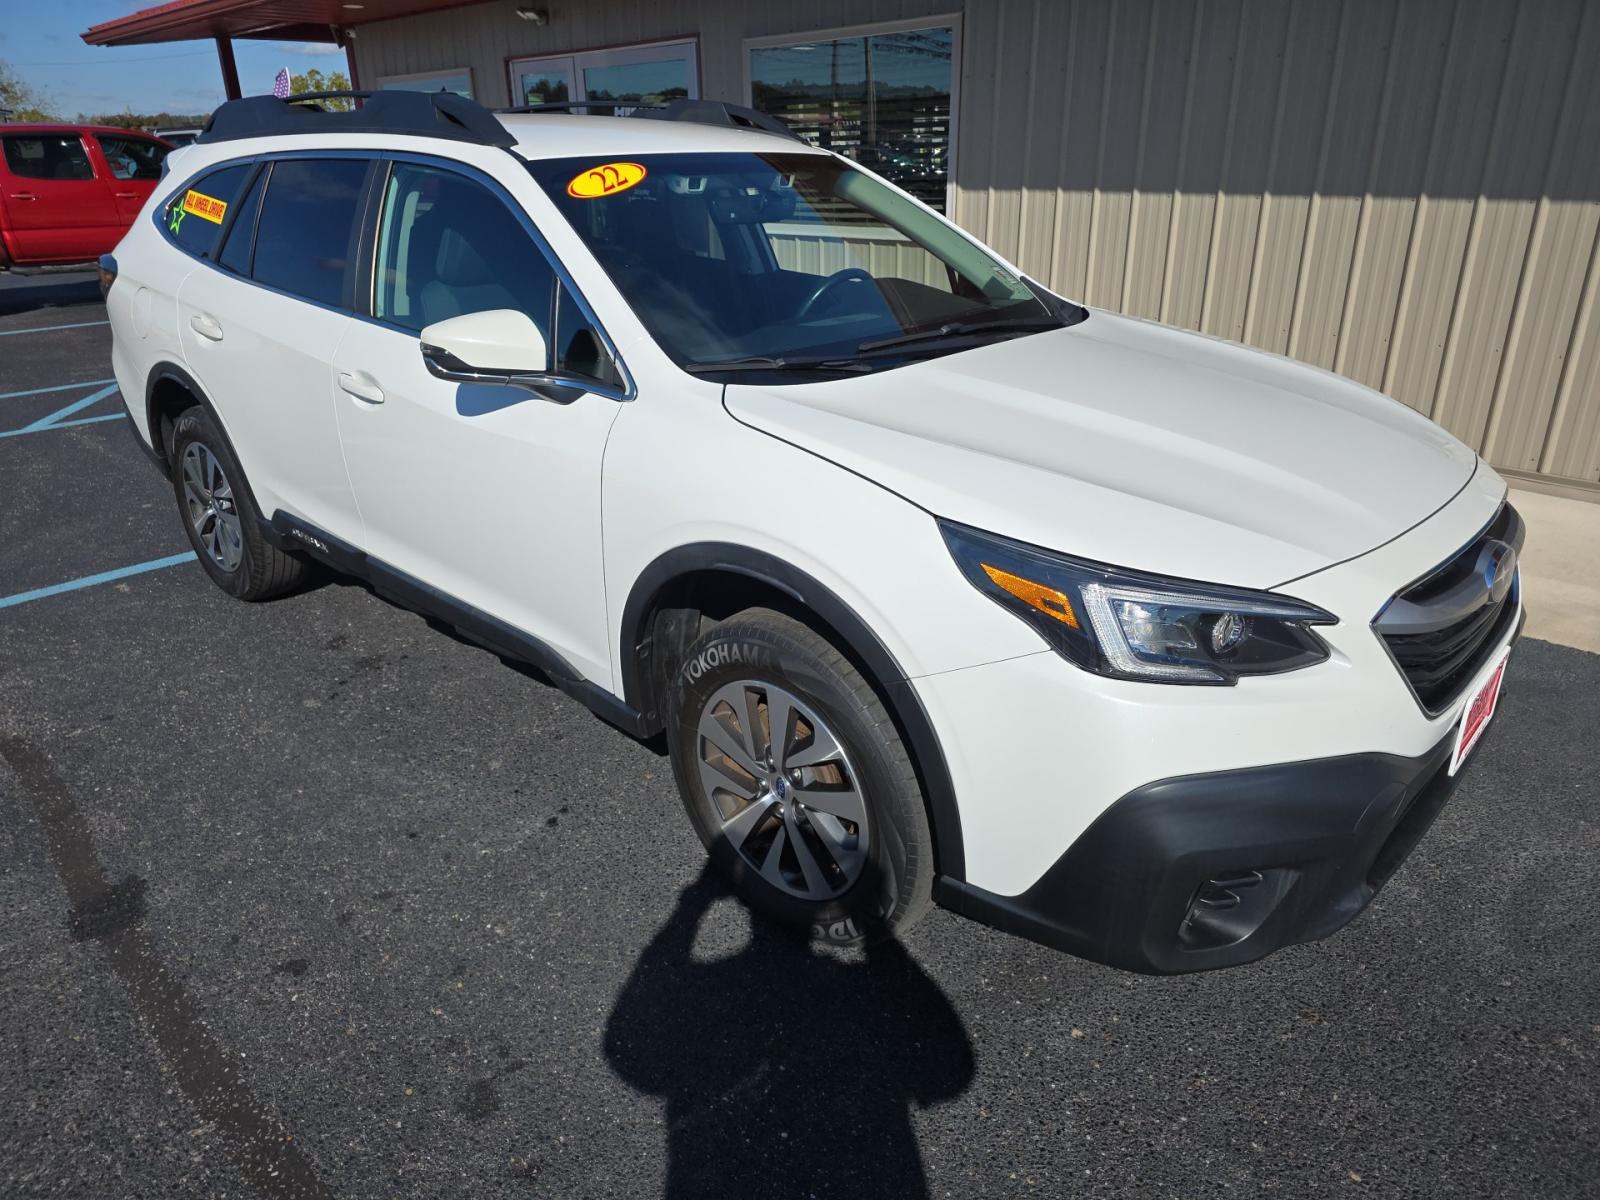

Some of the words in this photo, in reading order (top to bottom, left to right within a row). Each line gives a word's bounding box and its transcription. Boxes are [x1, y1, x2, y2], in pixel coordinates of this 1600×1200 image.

[589, 166, 628, 192] 22
[186, 193, 195, 207] ALL
[194, 197, 209, 214] WHEEL
[208, 201, 224, 218] DRIVE
